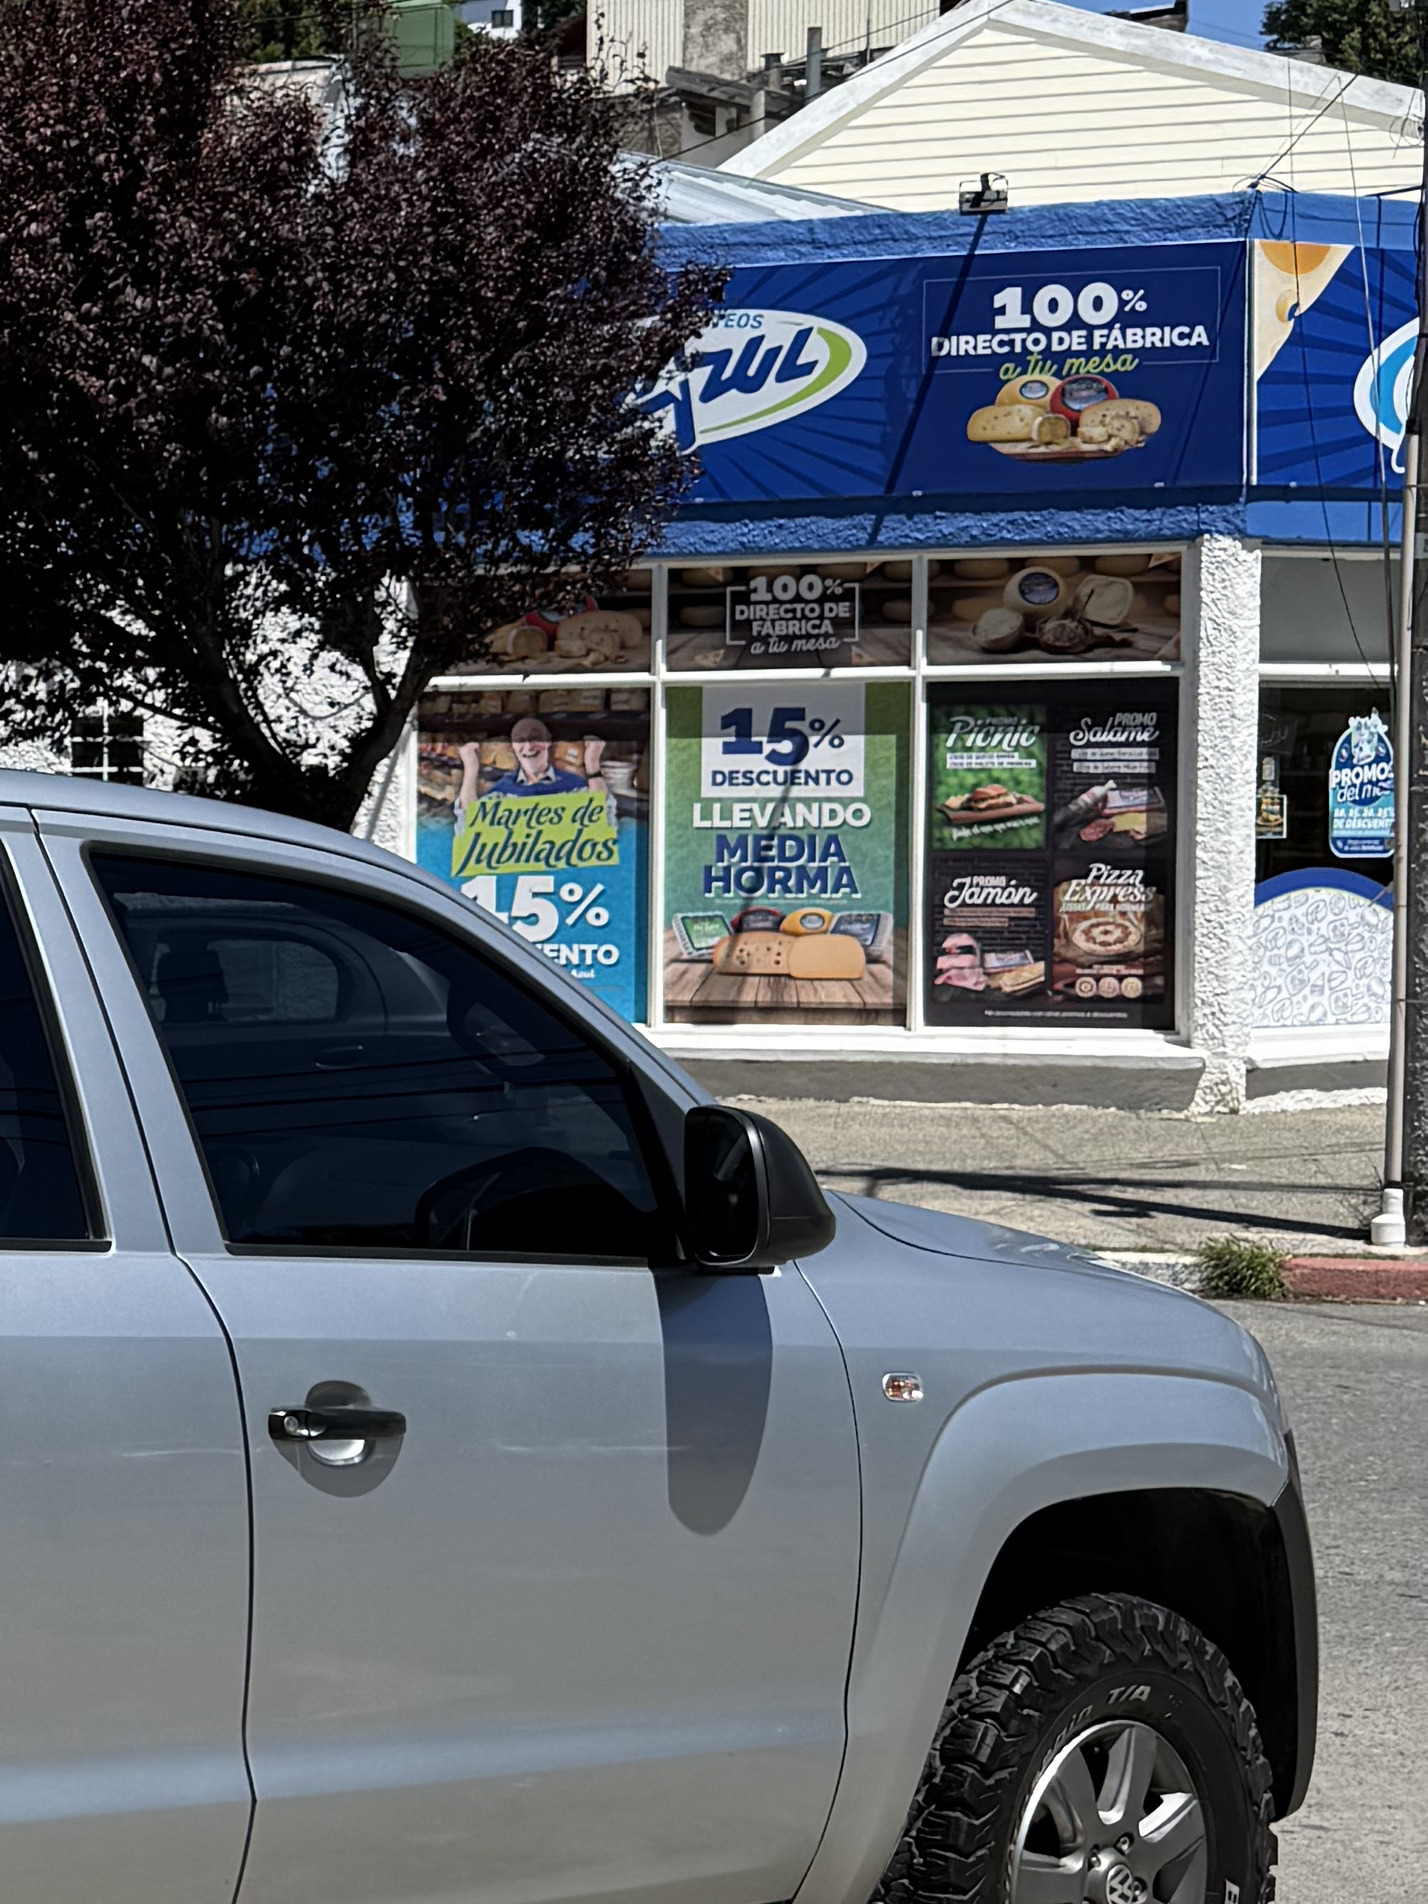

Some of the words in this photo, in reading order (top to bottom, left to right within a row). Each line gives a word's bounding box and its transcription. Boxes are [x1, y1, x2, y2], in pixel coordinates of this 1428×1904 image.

[993, 282, 1148, 329] 100%
[931, 331, 1048, 356] DIRECTO
[1051, 329, 1087, 352] DE
[1092, 323, 1210, 350] FÁBRICA
[999, 361, 1021, 381] a
[1026, 352, 1057, 377] tu
[1062, 352, 1140, 376] mesa
[749, 574, 843, 602] 100%
[735, 603, 821, 620] DIRECTO
[824, 602, 851, 618] DE
[752, 617, 834, 636] FÁBRICA
[750, 641, 764, 654] a
[768, 635, 787, 653] tu
[791, 637, 841, 652] mesa
[1069, 717, 1160, 746] Salame
[1114, 712, 1158, 726] PROMO
[720, 707, 845, 767] 15%
[946, 716, 1041, 752] Picnic
[711, 769, 854, 787] DESCUENTO
[469, 800, 567, 829] Martes
[570, 797, 604, 827] de
[693, 802, 872, 828] LLEVANDO
[455, 828, 619, 876] Jubilados
[715, 833, 850, 866] MEDIA
[703, 865, 862, 898] HORMA
[973, 876, 1006, 886] PROMO
[1086, 862, 1144, 887] Pizza
[944, 876, 1038, 908] Jamón
[1064, 879, 1157, 910] Express
[460, 875, 610, 943] 15%
[1108, 1685, 1151, 1704] T/A
